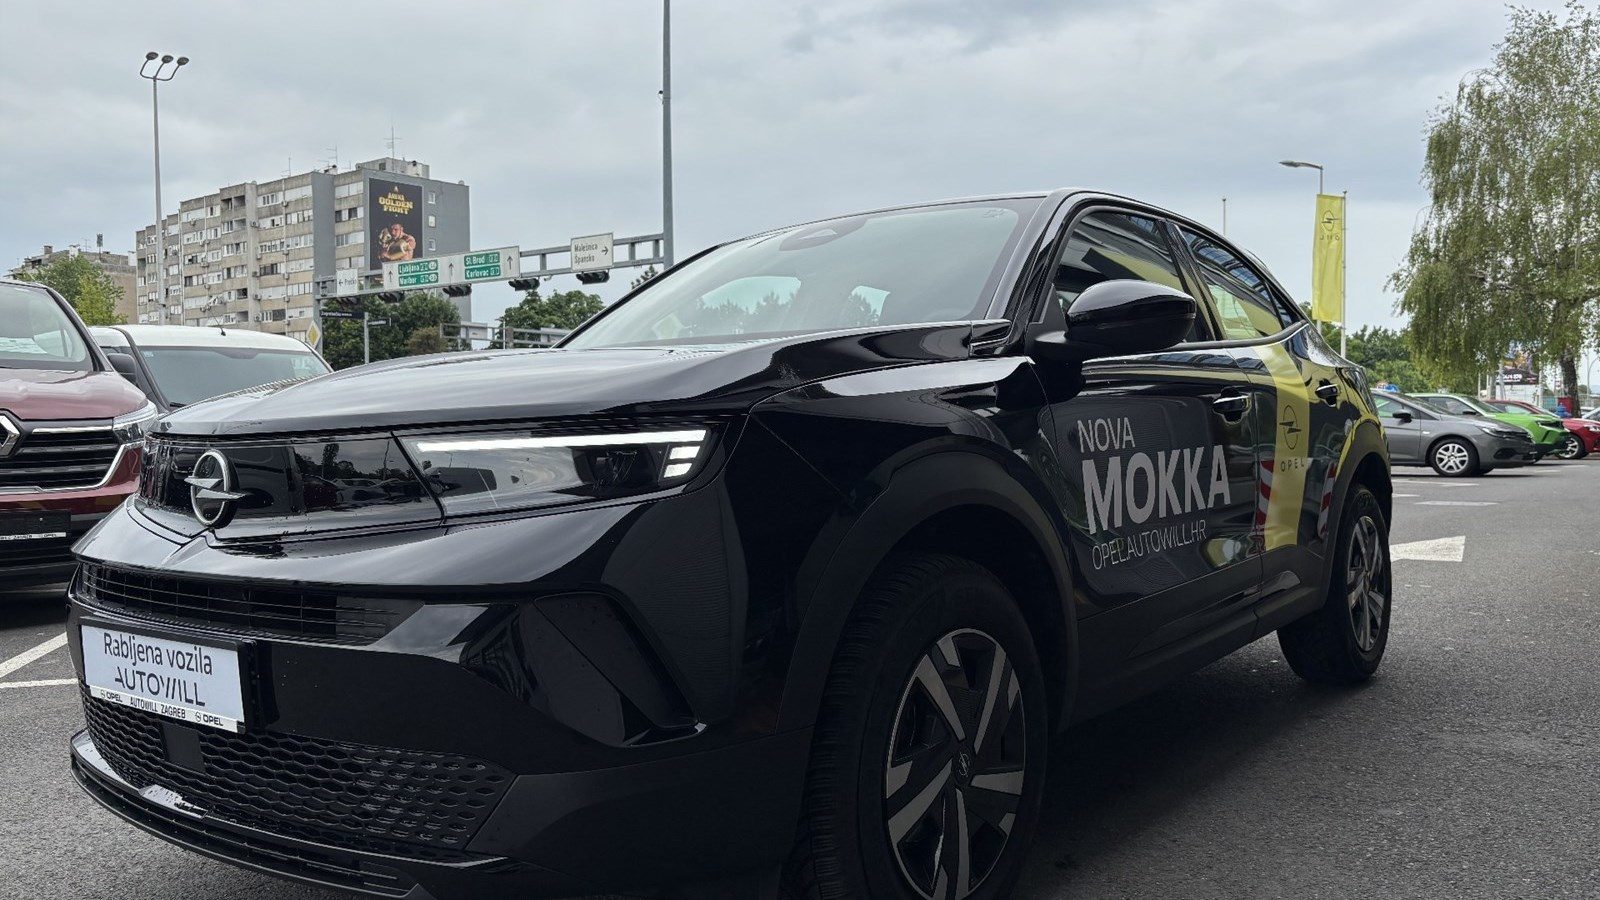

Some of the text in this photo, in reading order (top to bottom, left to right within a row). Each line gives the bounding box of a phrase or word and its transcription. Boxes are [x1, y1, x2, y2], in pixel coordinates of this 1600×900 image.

[379, 196, 414, 209] GOLDEN
[383, 204, 410, 215] FIGHT
[1077, 417, 1136, 453] NOVA
[1280, 458, 1305, 472] OPEL
[1081, 444, 1232, 535] MOKKA
[104, 632, 213, 676] Rabljena vozila
[106, 691, 224, 727] OPEL AUTOWILL ZAGREB OPEL
